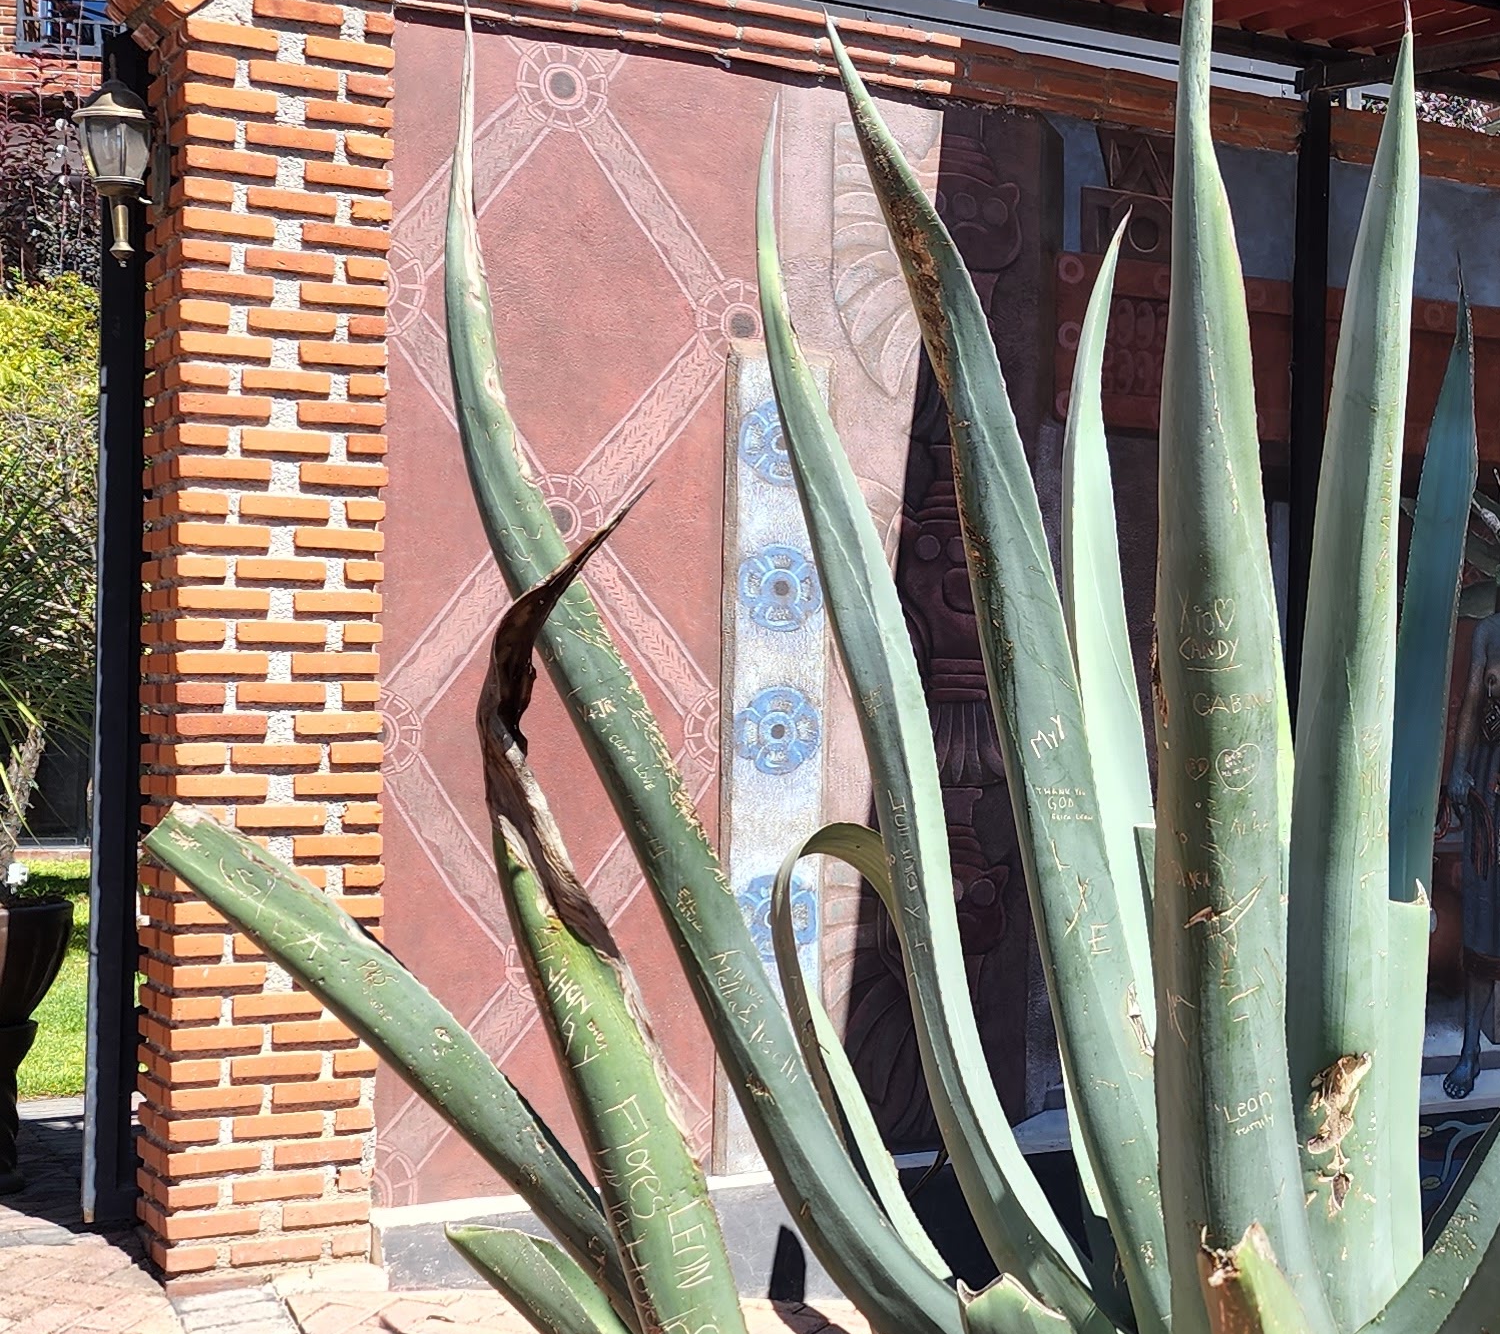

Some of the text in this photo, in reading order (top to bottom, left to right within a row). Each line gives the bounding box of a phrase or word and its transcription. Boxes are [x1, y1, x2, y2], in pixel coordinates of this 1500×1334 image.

[1179, 637, 1239, 663] CANDY
[1047, 796, 1076, 813] GOD
[601, 1094, 665, 1221] Flores
